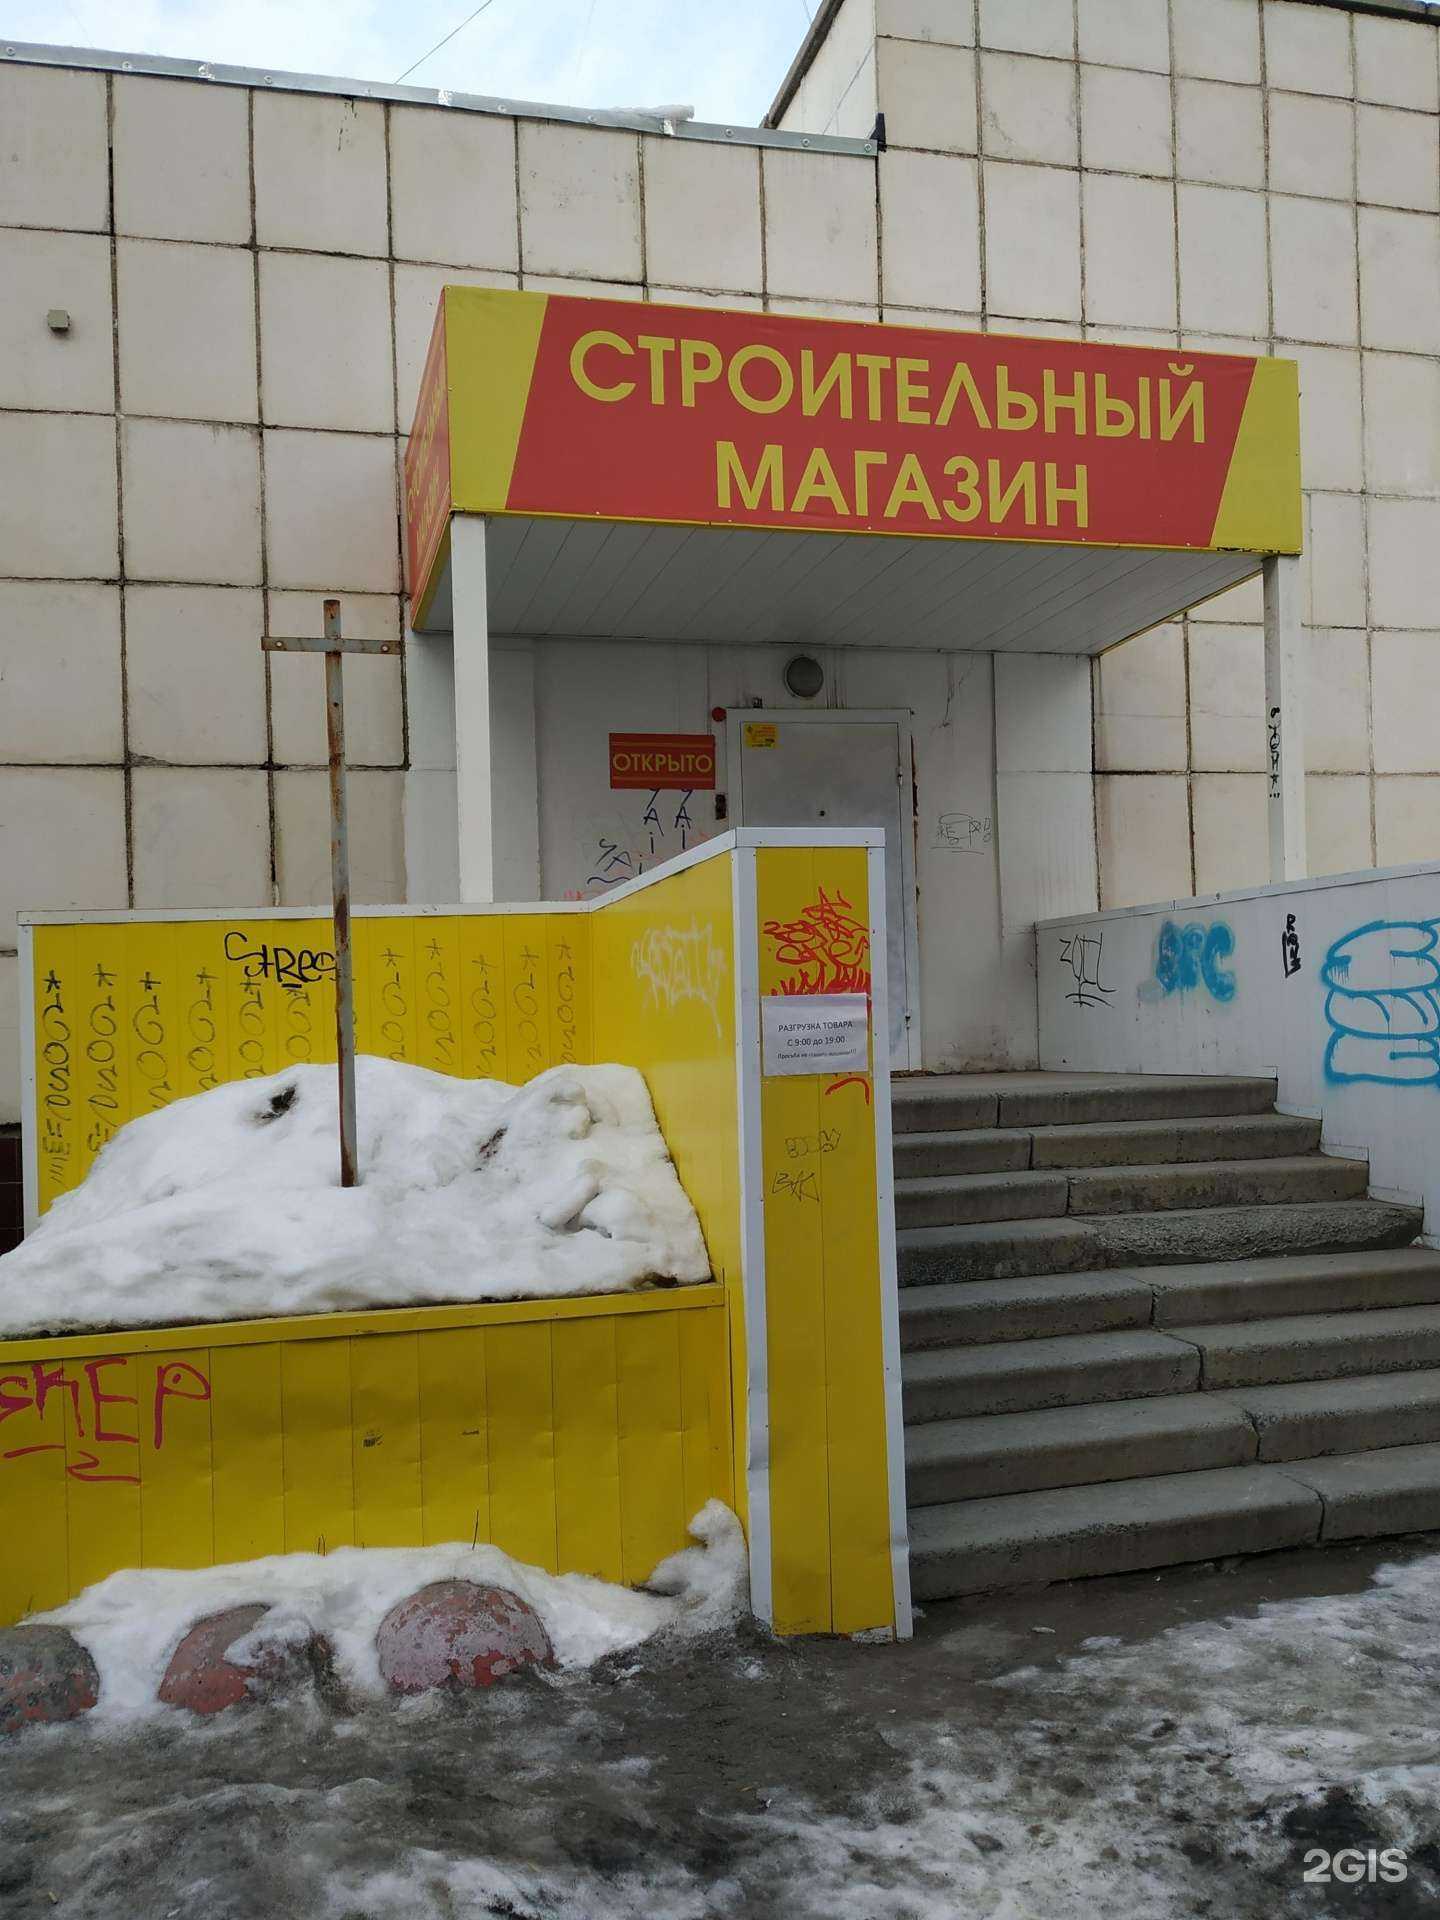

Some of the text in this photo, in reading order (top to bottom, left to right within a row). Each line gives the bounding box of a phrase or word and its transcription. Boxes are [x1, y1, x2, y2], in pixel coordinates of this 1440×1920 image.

[568, 329, 1207, 445] СТРОИТЕЛЬНЫЙ
[714, 440, 1090, 529] МАГАЗИН
[612, 753, 713, 773] ОТКРЫТО
[778, 1020, 853, 1032] РАЗГРУЗКА ТОВАРА
[794, 1037, 812, 1047] 9:00
[812, 1038, 823, 1047] до
